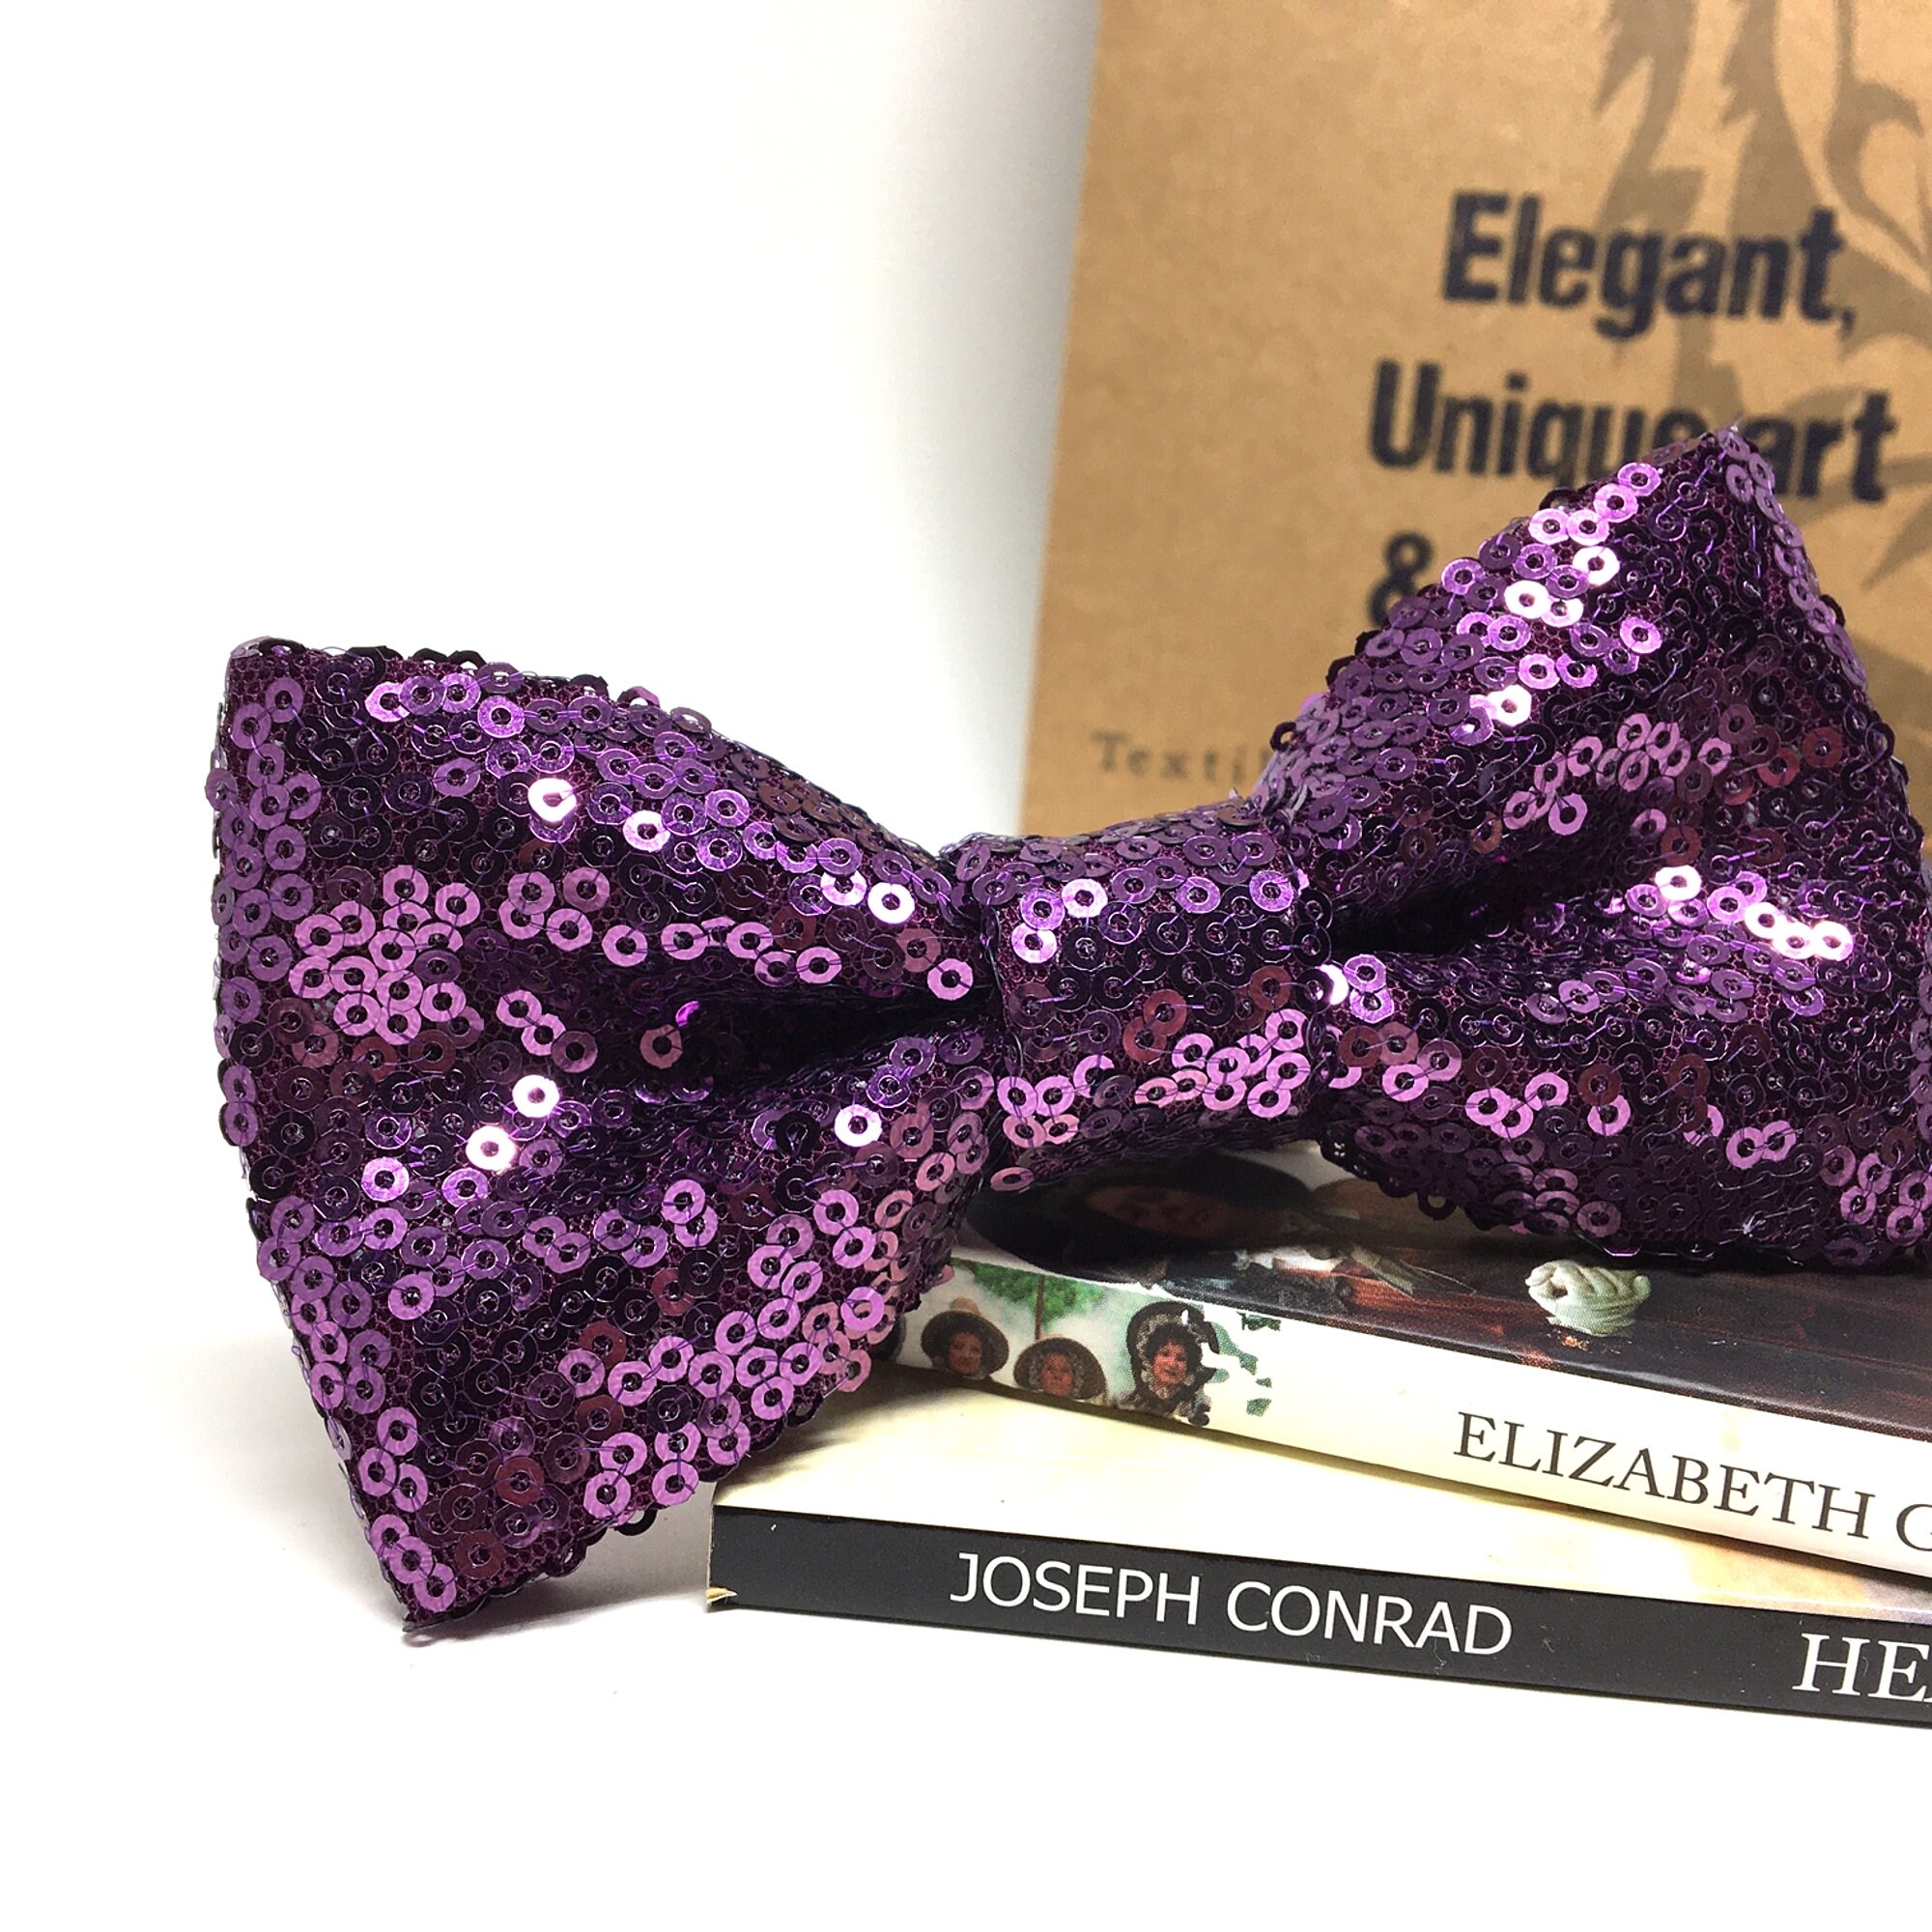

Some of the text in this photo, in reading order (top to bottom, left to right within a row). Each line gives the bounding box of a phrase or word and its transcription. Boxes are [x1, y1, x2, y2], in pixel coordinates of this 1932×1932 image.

[1442, 190, 1857, 340] Elegant,
[1740, 391, 1896, 502] art
[1368, 530, 1434, 628] &
[1453, 1411, 1876, 1540] ELIZABETH
[950, 1552, 1932, 1703] JOSEPH CONRAD HE
